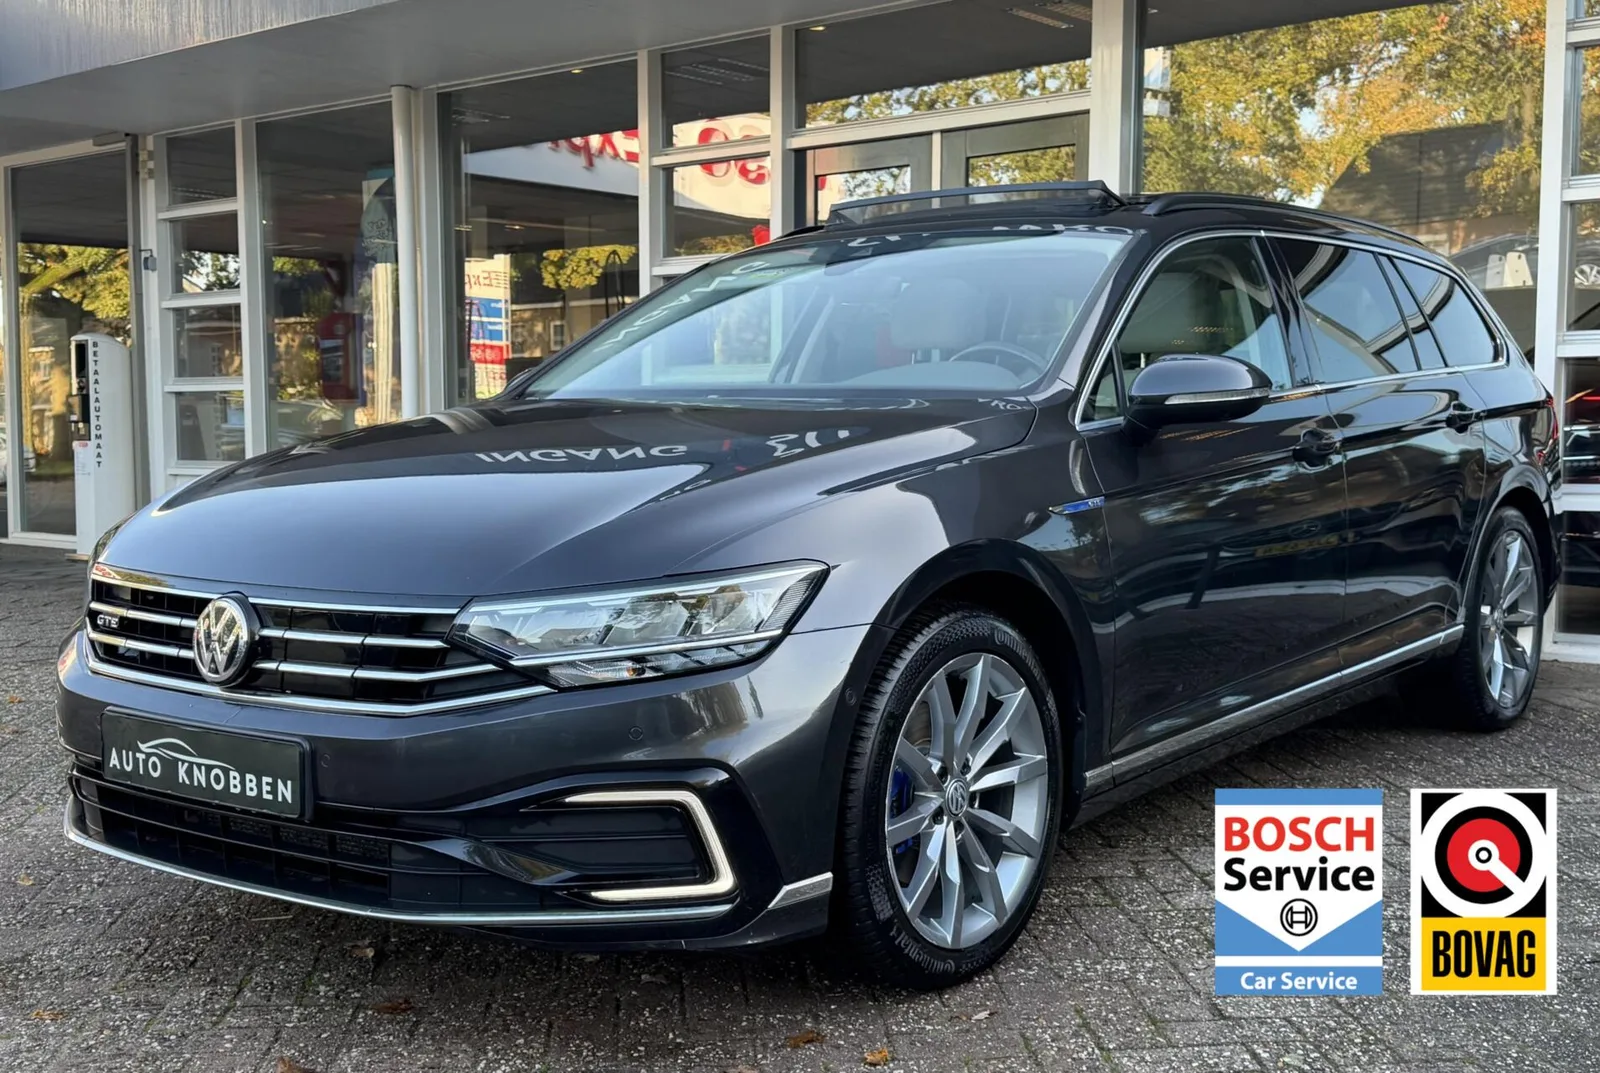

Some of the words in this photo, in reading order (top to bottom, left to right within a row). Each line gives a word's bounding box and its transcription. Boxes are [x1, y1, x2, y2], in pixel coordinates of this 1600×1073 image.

[92, 341, 103, 468] BETAALAUTOMAAT
[109, 747, 161, 778] AUTO
[178, 761, 292, 804] KNOBBEN
